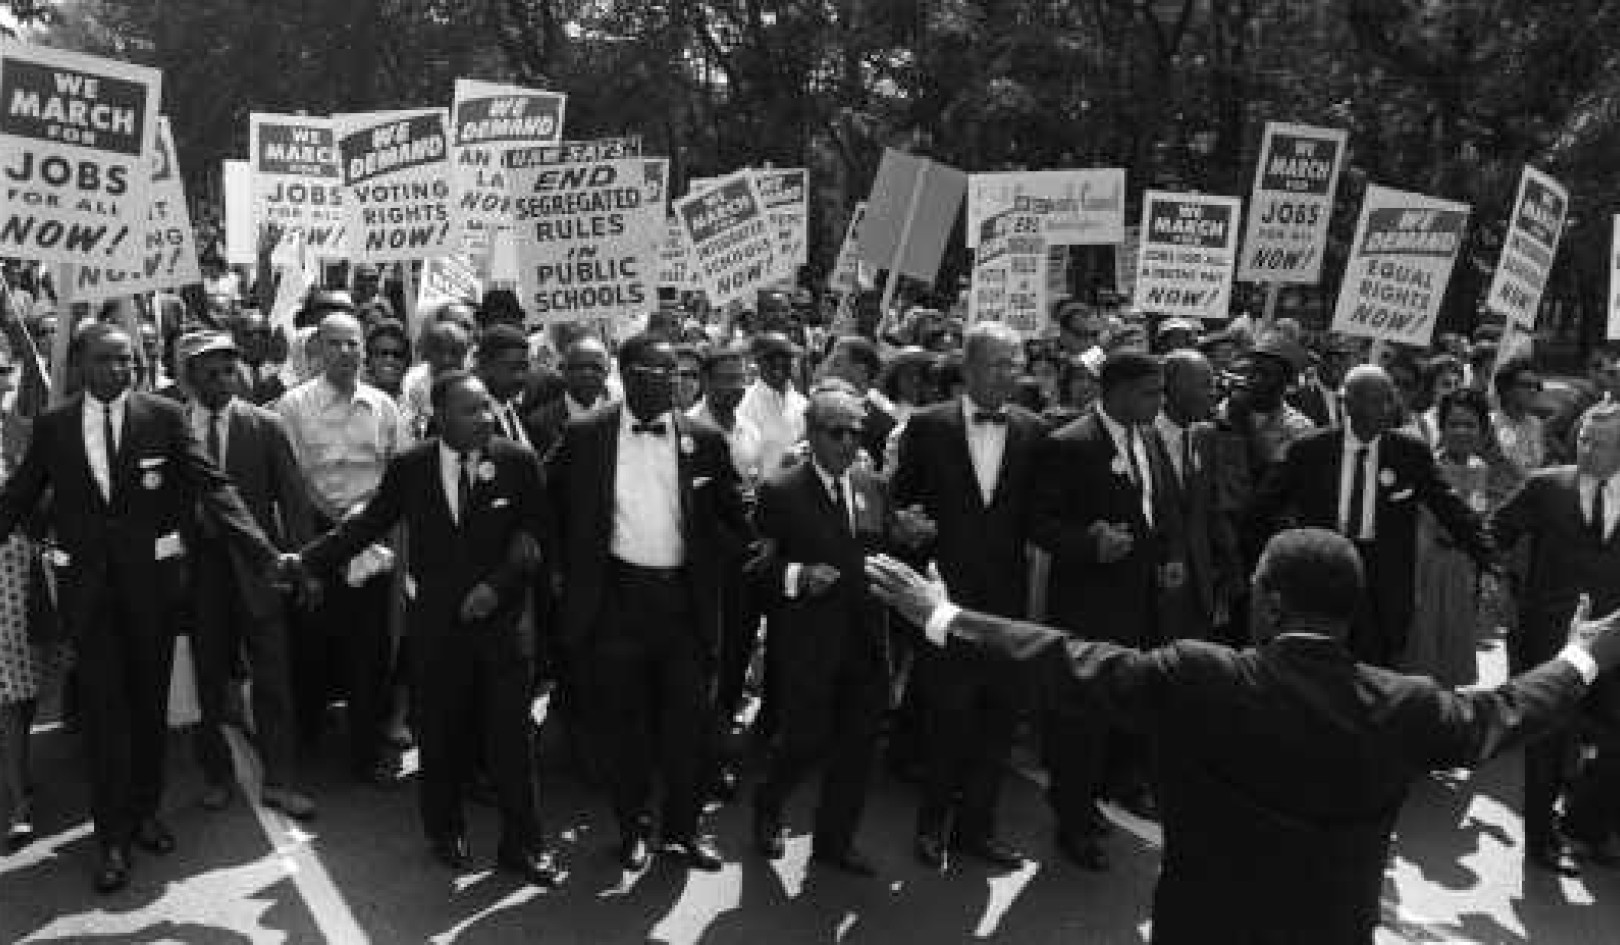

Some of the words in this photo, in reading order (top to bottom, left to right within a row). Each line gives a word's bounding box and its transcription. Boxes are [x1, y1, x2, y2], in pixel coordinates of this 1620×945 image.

[54, 72, 98, 98] WE
[10, 88, 135, 134] MARCH
[488, 97, 529, 118] WE
[47, 123, 96, 145] FOR
[292, 126, 321, 145] WE
[371, 121, 410, 148] WE
[460, 116, 555, 142] DEMAND
[350, 134, 445, 178] DEMAND
[1269, 157, 1330, 180] MARCH
[6, 153, 128, 195] JOBS
[533, 167, 618, 193] END
[7, 188, 60, 207] FOR
[267, 182, 343, 205] JOBS
[353, 180, 449, 203] VOTING
[515, 187, 639, 220] SEGREGATED
[362, 204, 448, 224] RIGHTS
[1261, 202, 1317, 224] JOBS
[0, 213, 129, 255] NOW!
[364, 219, 450, 251] NOW!
[536, 214, 624, 242] RULES
[1154, 216, 1224, 239] MARCH
[537, 256, 636, 284] PUBLIC
[1255, 246, 1316, 271] NOW!
[1368, 259, 1431, 288] EQUAL
[534, 284, 645, 313] SCHOOLS
[1148, 287, 1221, 305] NOW!
[1359, 279, 1431, 312] RIGHTS
[1350, 304, 1429, 336] NOW!
